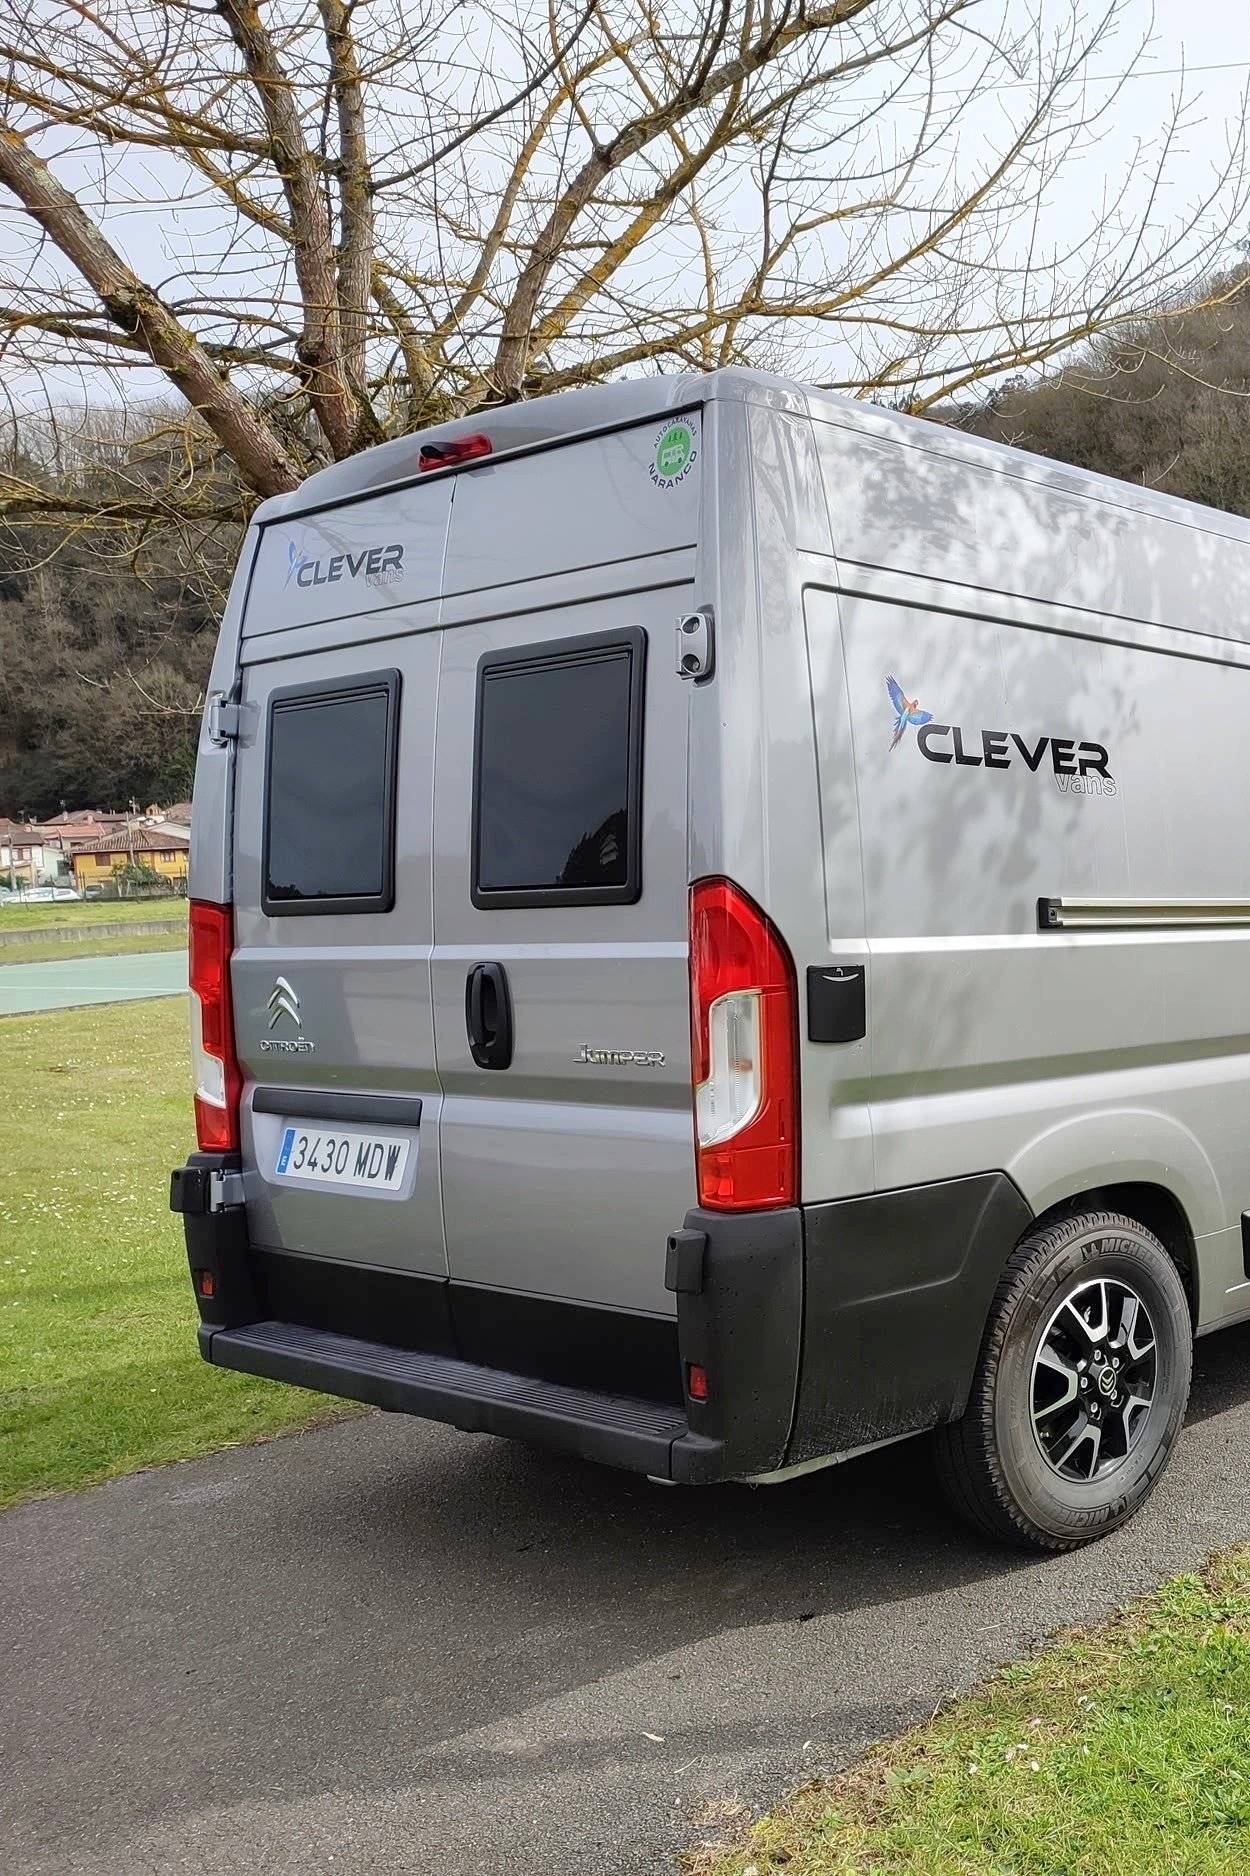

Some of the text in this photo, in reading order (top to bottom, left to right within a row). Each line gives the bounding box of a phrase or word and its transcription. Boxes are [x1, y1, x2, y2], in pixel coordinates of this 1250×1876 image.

[648, 450, 698, 489] NARANCO
[297, 544, 404, 588] CLEVER
[364, 569, 405, 587] vans
[916, 723, 1113, 779] CLEVER
[1054, 773, 1118, 797] vans
[293, 1136, 401, 1181] 3430 MDW
